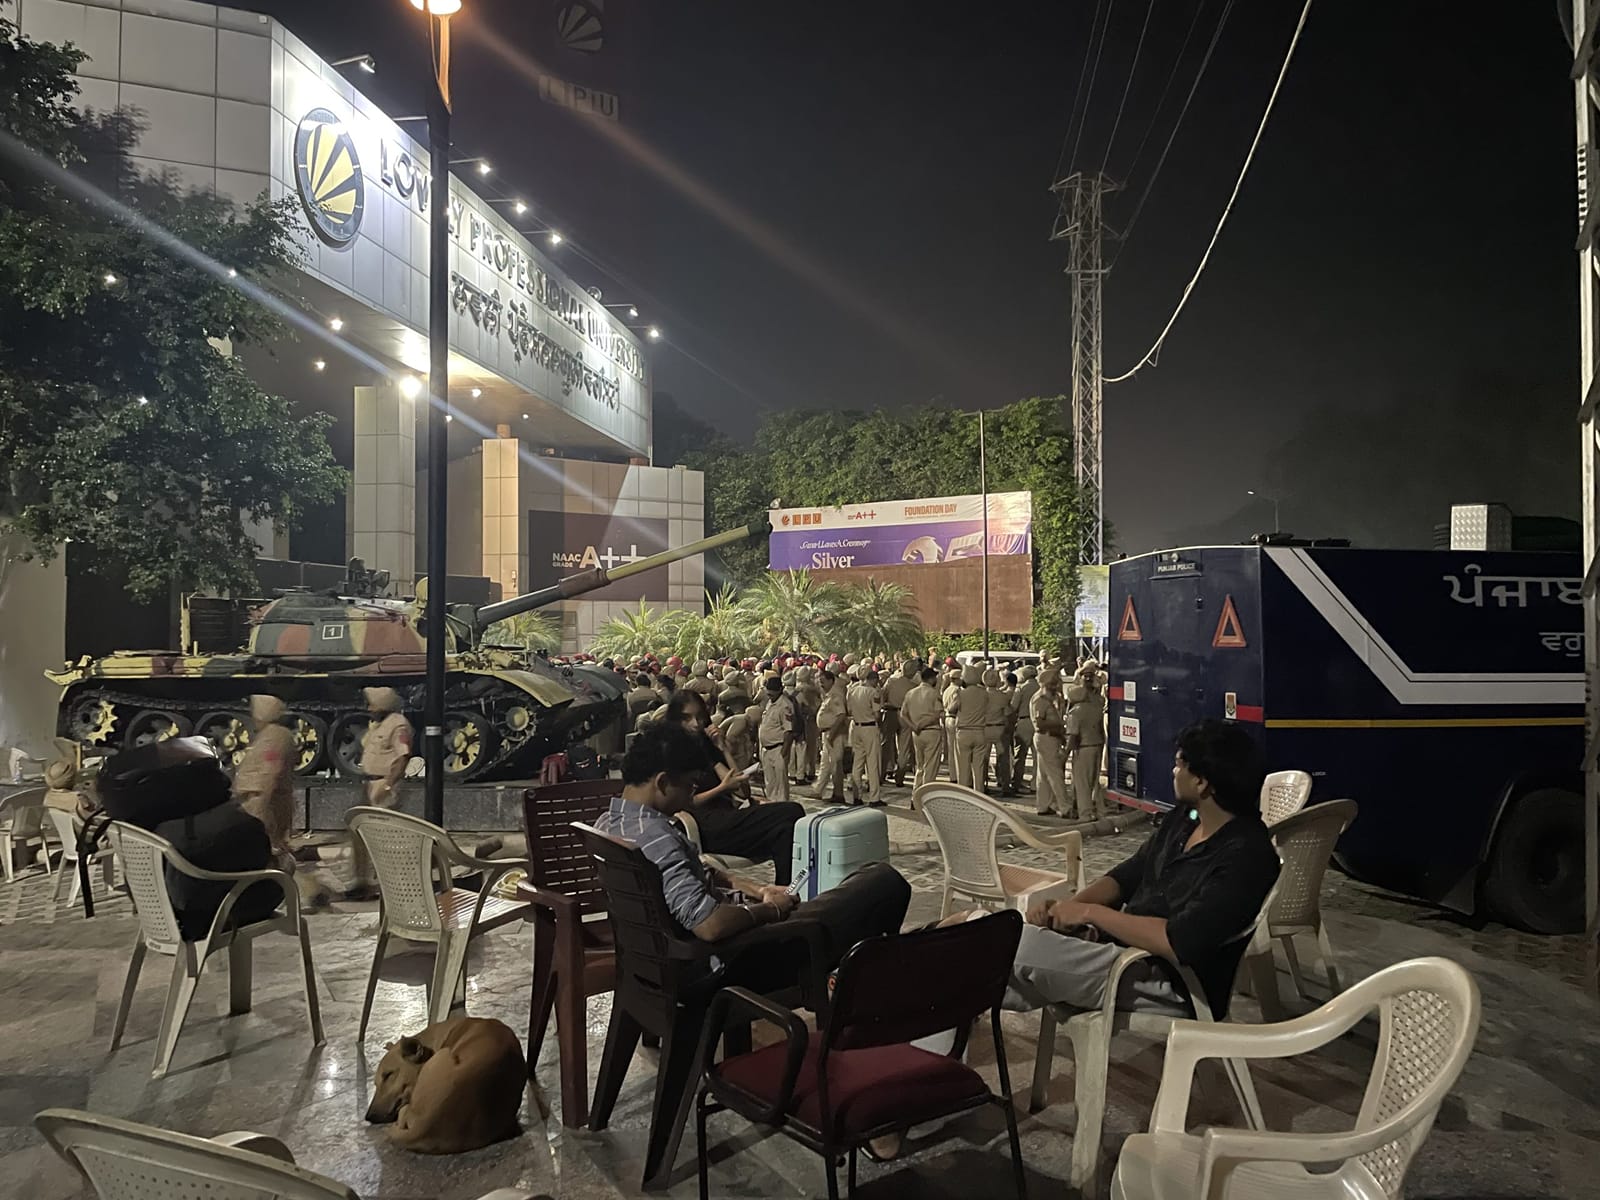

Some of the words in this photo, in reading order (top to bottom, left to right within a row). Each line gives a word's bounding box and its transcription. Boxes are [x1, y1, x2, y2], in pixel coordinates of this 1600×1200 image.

[380, 137, 465, 240] LOVY
[469, 212, 586, 335] PROFESSIONAL
[586, 310, 645, 381] UNIVERSITY
[904, 504, 943, 516] FOUNDATION
[944, 503, 957, 513] DAY
[552, 552, 581, 562] NAAC
[811, 552, 855, 570] Silver
[1538, 632, 1585, 657] ਵਰੁ
[1122, 725, 1137, 737] STOP
